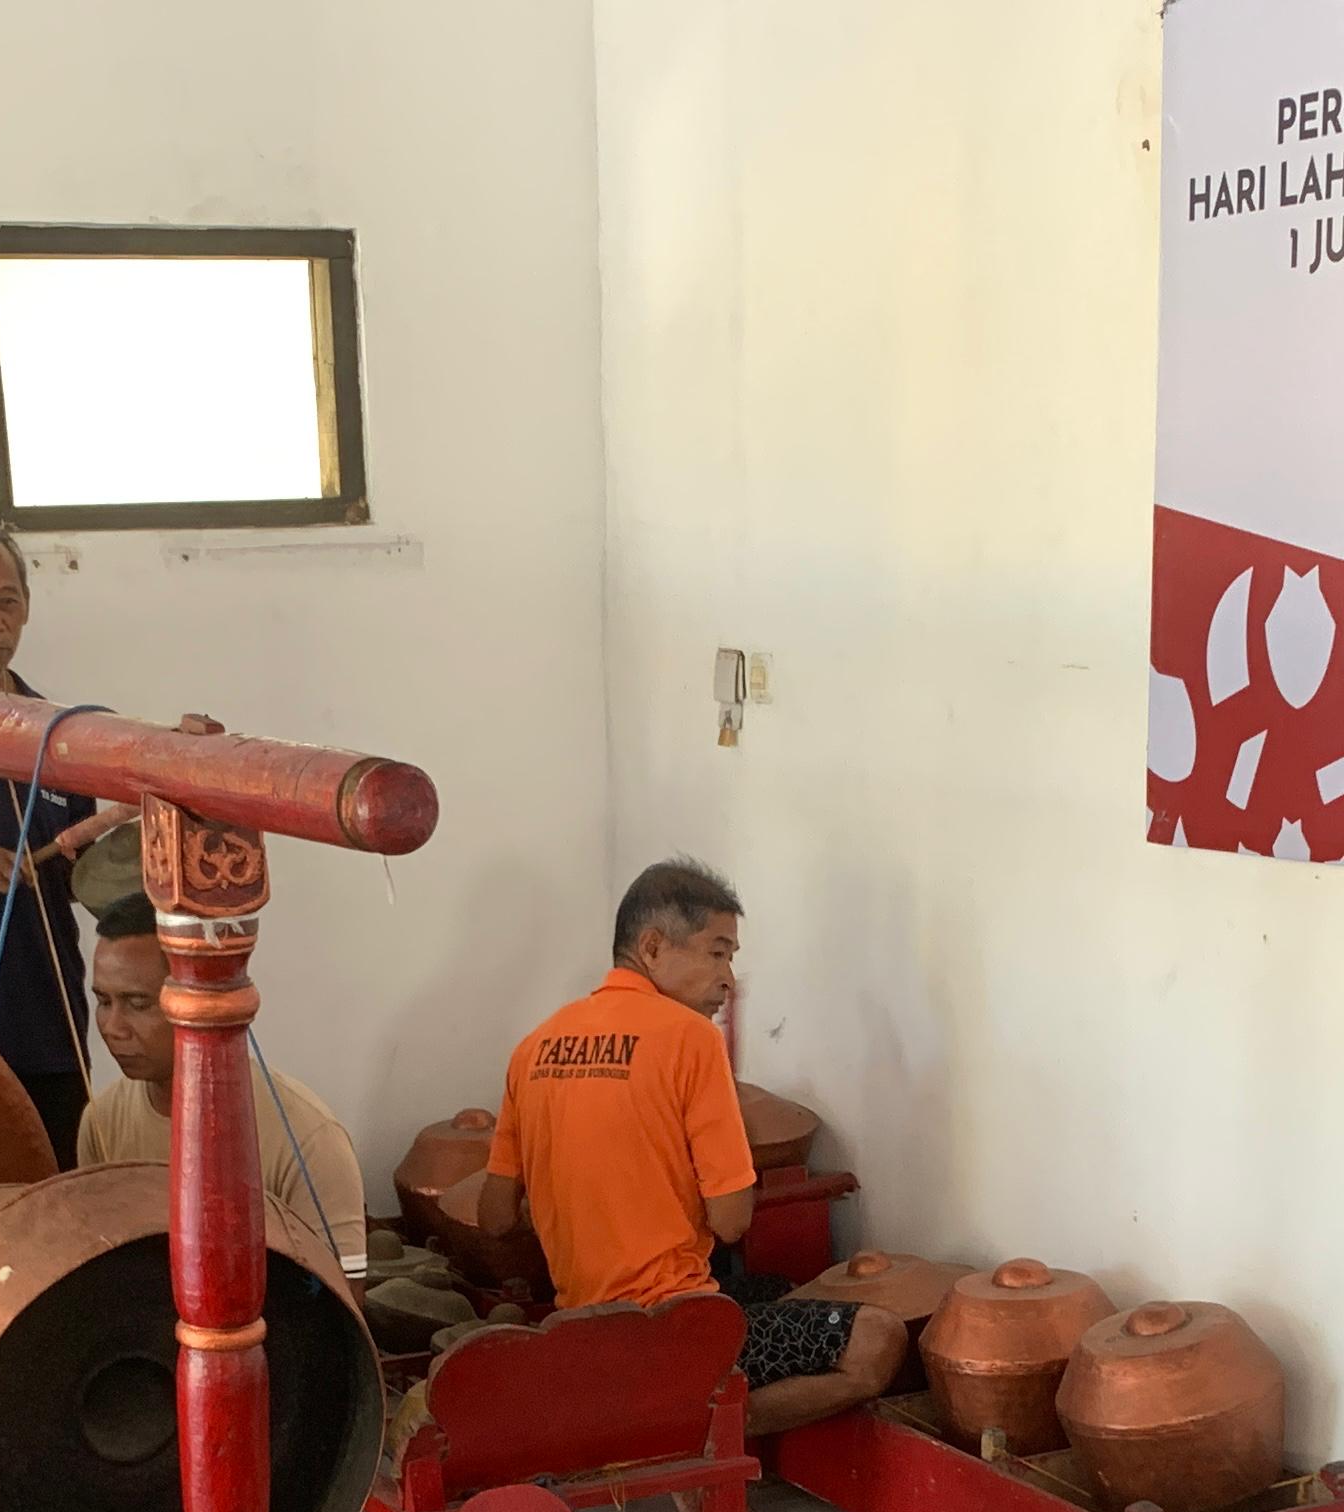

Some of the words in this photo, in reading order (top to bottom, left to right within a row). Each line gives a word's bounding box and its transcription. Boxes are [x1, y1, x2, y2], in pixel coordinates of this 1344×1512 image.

[1188, 165, 1267, 221] HARI
[1288, 228, 1300, 268] 1
[534, 1033, 640, 1066] TAHANAN
